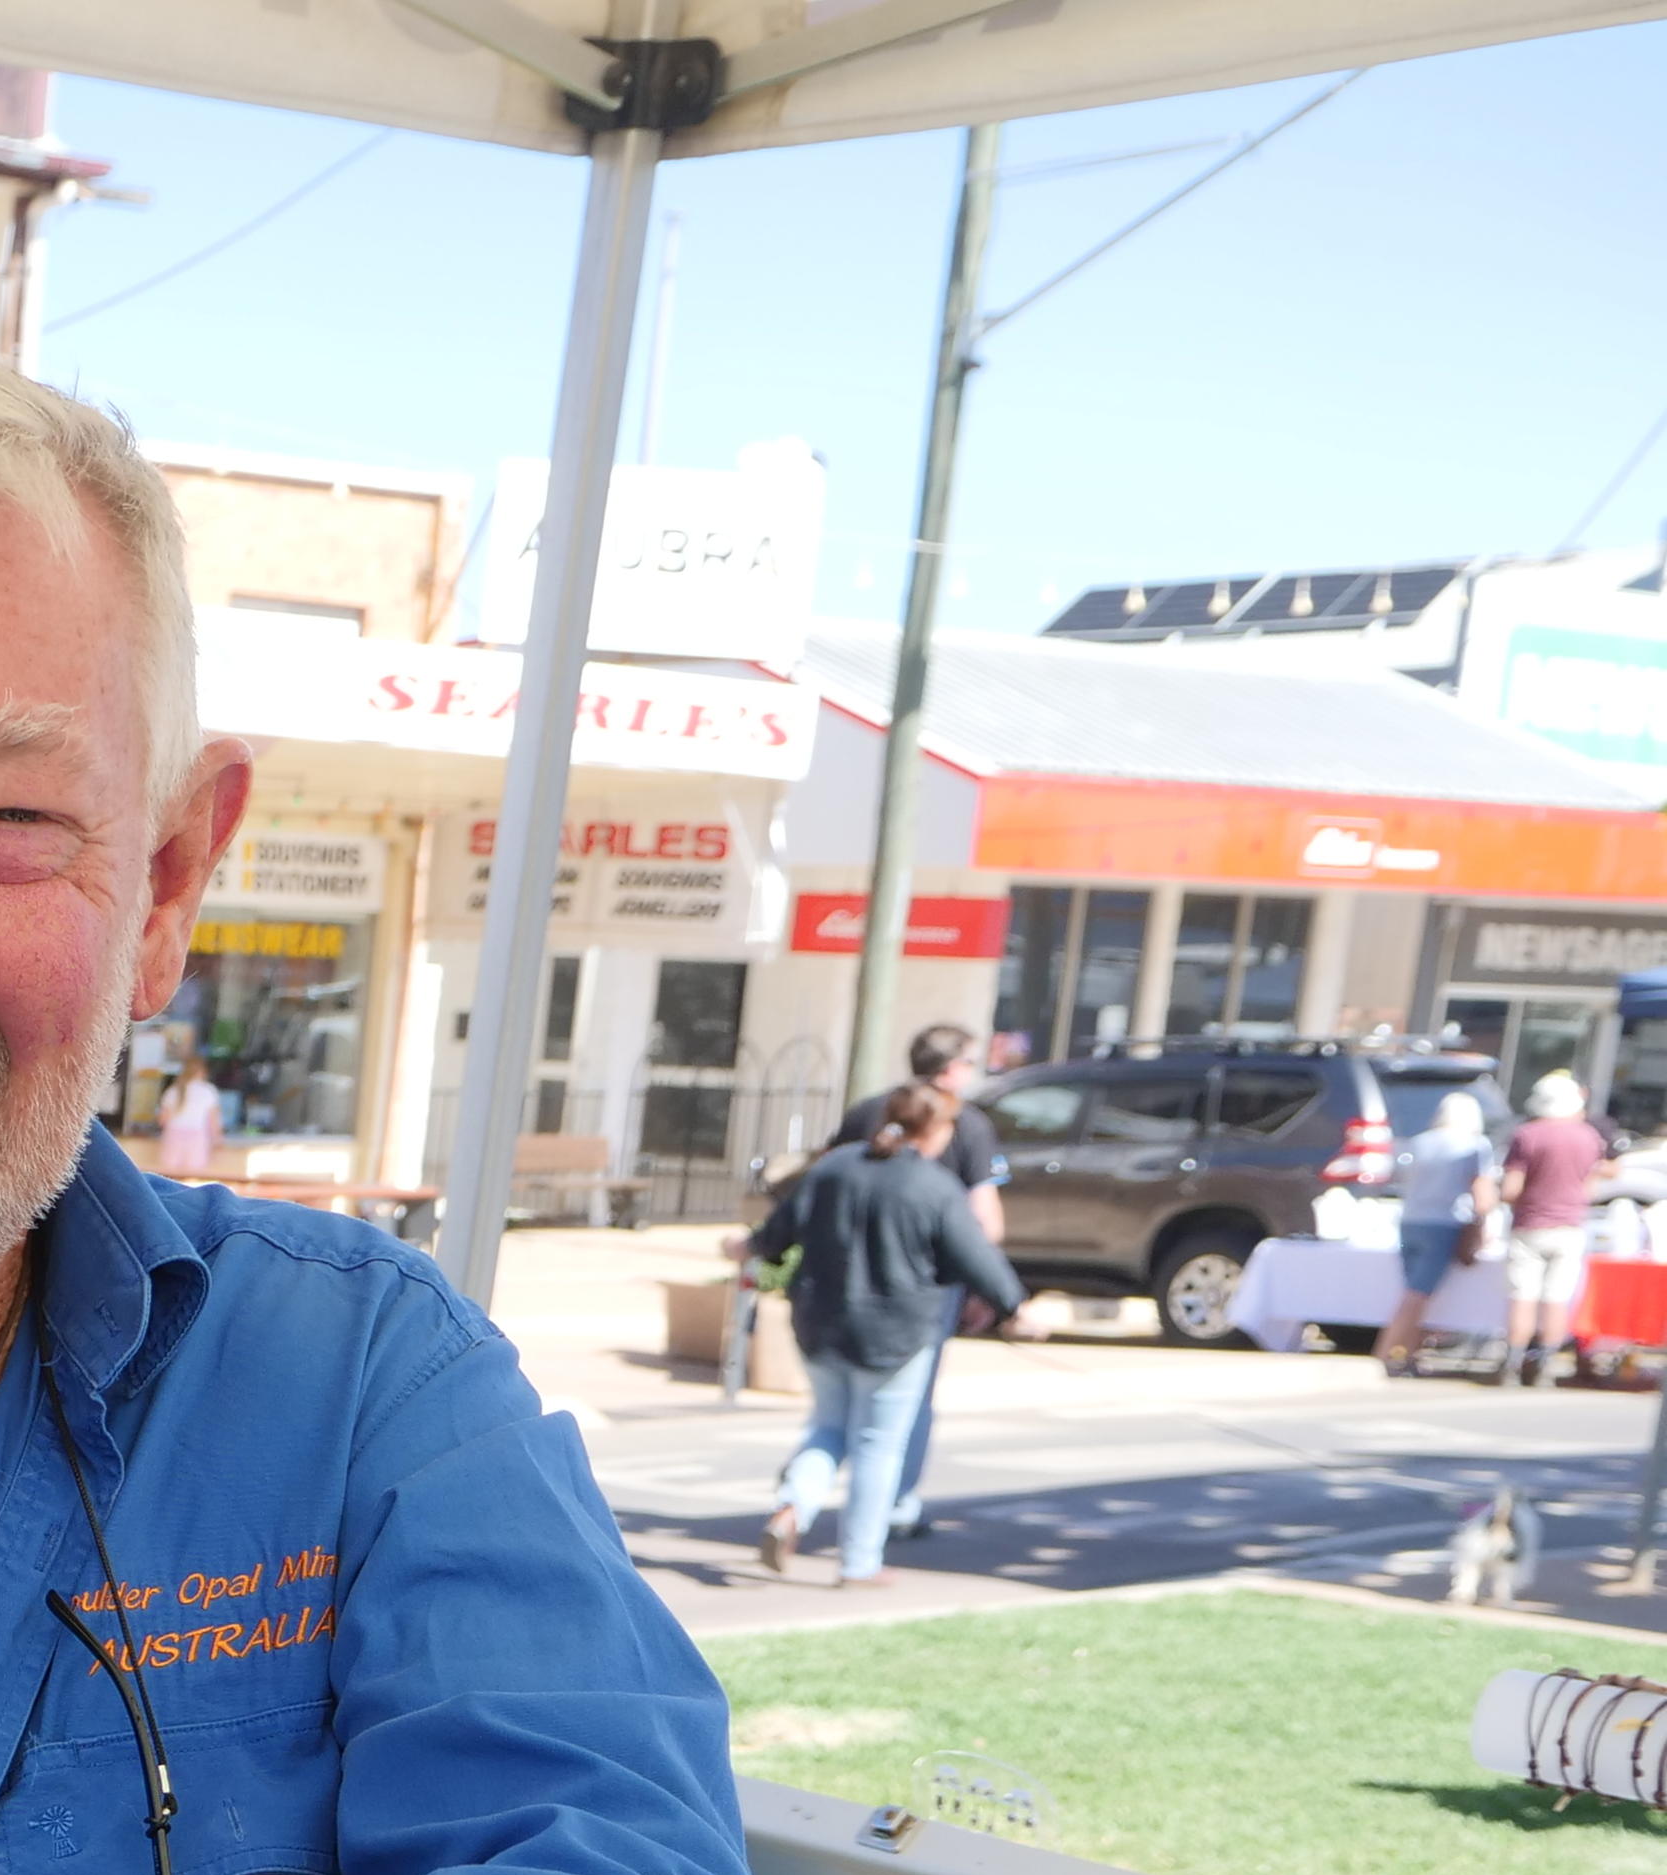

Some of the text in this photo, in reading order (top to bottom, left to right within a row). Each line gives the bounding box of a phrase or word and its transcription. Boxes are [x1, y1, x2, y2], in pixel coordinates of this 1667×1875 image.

[517, 520, 779, 576] AUBRA
[178, 1563, 264, 1610] Opal
[88, 1605, 337, 1677] AUSTRALIA
